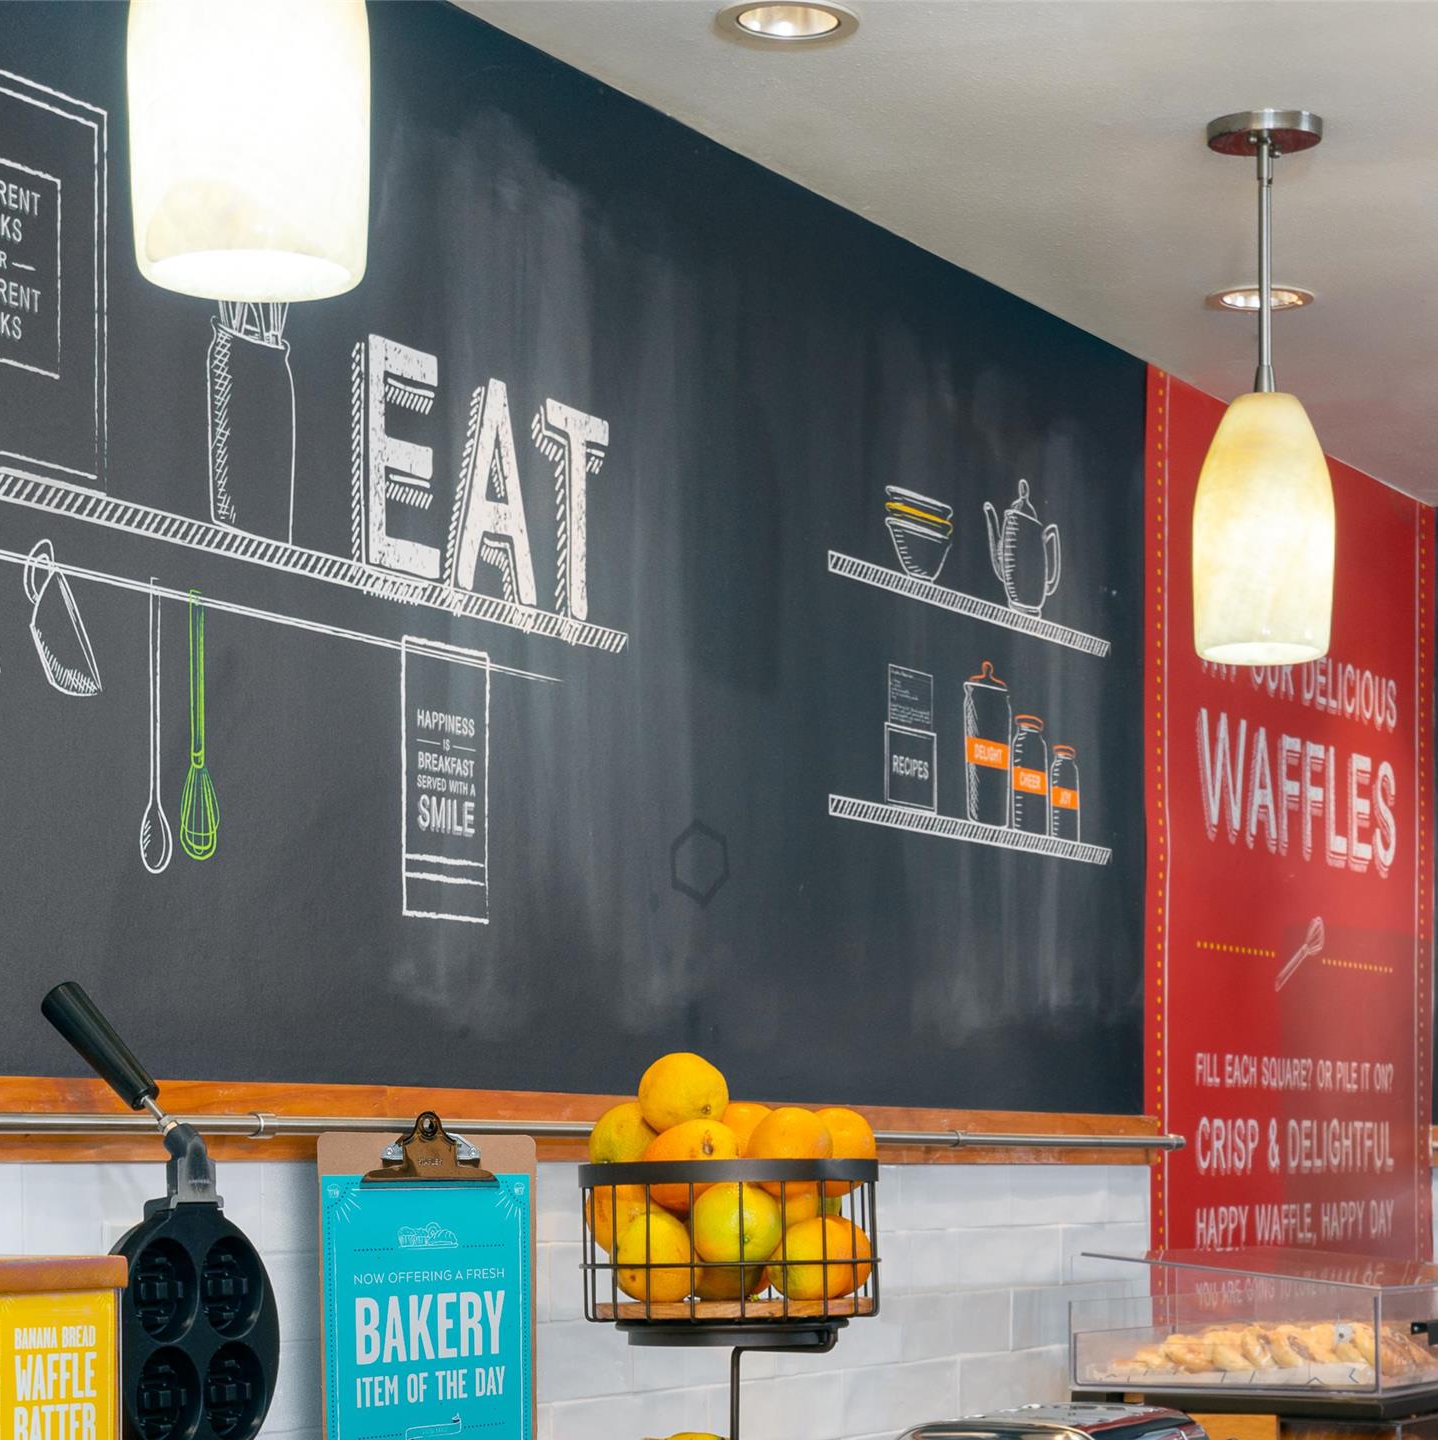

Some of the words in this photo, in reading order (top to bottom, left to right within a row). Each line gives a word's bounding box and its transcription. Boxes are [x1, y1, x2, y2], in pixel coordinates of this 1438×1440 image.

[352, 333, 609, 622] EAT
[1301, 656, 1397, 732] DELICIOUS
[417, 708, 475, 738] HAPPINESS
[417, 751, 475, 778] BREAKFAST
[442, 738, 451, 752] IS
[974, 743, 1003, 765] DELIGHT
[416, 774, 447, 792] SERVED
[448, 779, 468, 796] WITH
[470, 783, 477, 798] A
[892, 754, 929, 780] RECIPES
[1197, 707, 1397, 879] WAFFLES
[417, 794, 476, 837] SMILE
[1195, 1052, 1221, 1088] FILL
[1225, 1054, 1257, 1088] EACH
[1262, 1056, 1313, 1090] SQUARE?
[1317, 1059, 1333, 1091] OR
[1336, 1061, 1358, 1093] PILE
[1361, 1062, 1371, 1092] IT
[1373, 1063, 1394, 1093] ON?
[1196, 1116, 1260, 1175] CRISP
[1267, 1116, 1281, 1174] &
[1287, 1118, 1394, 1174] DELIGHTFUL
[1195, 1206, 1249, 1250] HAPPY
[1255, 1203, 1317, 1246] WAFFLE,
[1321, 1201, 1365, 1240] HAPPY
[1370, 1200, 1395, 1239] DAY
[353, 1273, 385, 1285] NOW
[388, 1269, 452, 1283] OFFERING
[455, 1270, 464, 1280] A
[466, 1268, 505, 1280] FRESH
[14, 1326, 58, 1350] BANANA
[62, 1325, 97, 1348] BREAD
[355, 1289, 506, 1365] BAKERY
[14, 1351, 98, 1402] WAFFLE
[356, 1374, 399, 1408] ITEM
[407, 1372, 428, 1403] OF
[435, 1369, 468, 1401] THE
[475, 1365, 506, 1397] DAY
